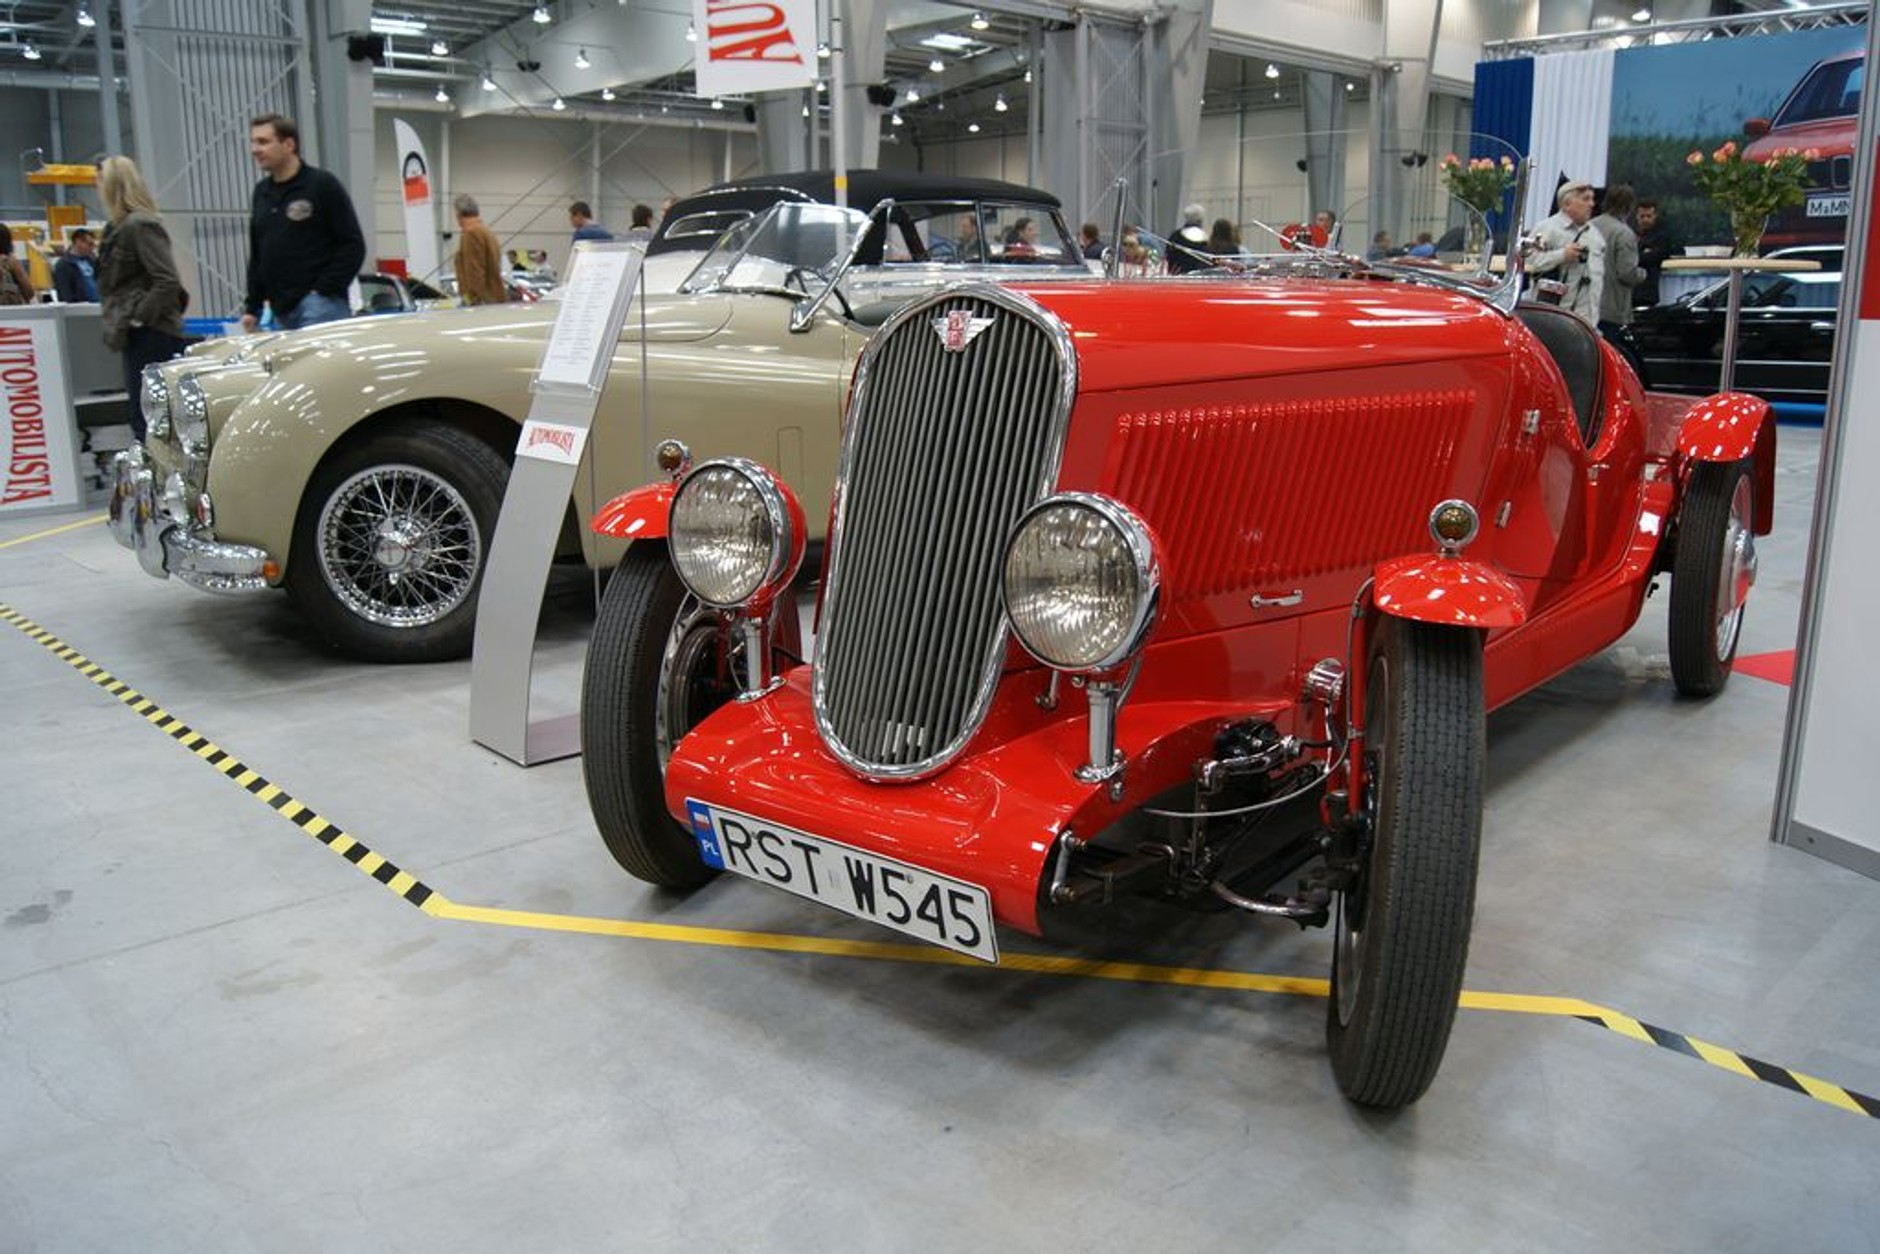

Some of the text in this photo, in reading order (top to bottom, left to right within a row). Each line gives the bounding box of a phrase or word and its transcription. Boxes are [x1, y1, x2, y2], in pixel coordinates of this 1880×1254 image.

[701, 839, 719, 856] PL
[718, 816, 981, 948] RST W545
